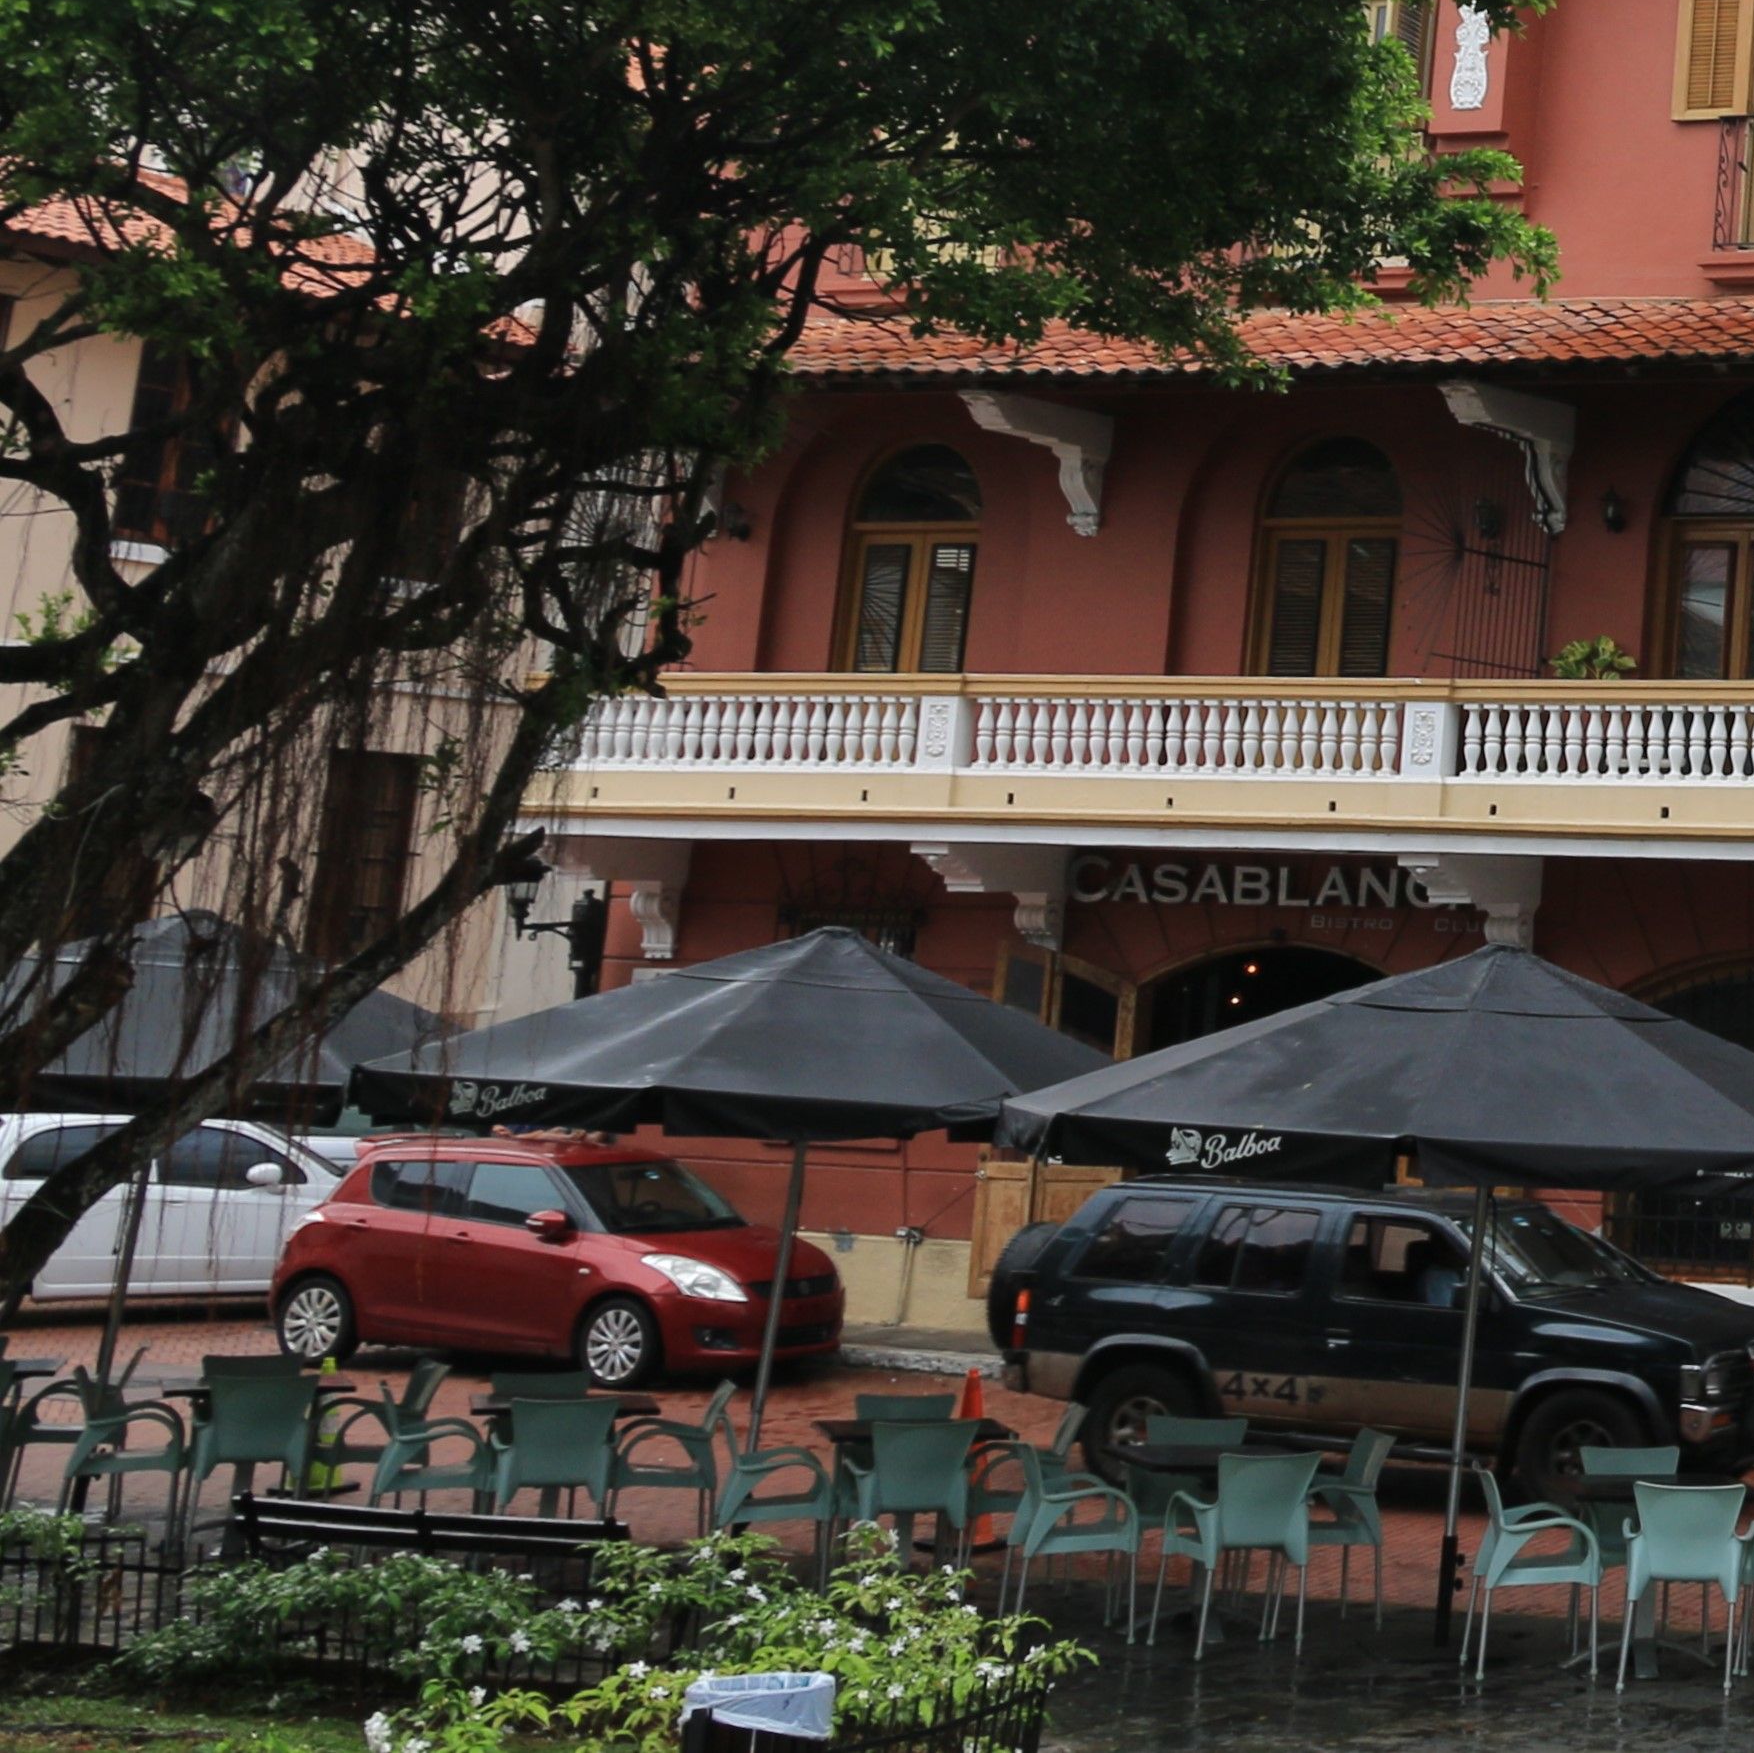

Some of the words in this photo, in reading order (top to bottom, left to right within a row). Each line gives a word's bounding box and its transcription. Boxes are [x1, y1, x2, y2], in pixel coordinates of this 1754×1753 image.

[1072, 855, 1458, 908] CASABLANC
[1433, 917, 1482, 933] CLU
[476, 1083, 547, 1117] Balboa
[1201, 1132, 1282, 1169] Balboa
